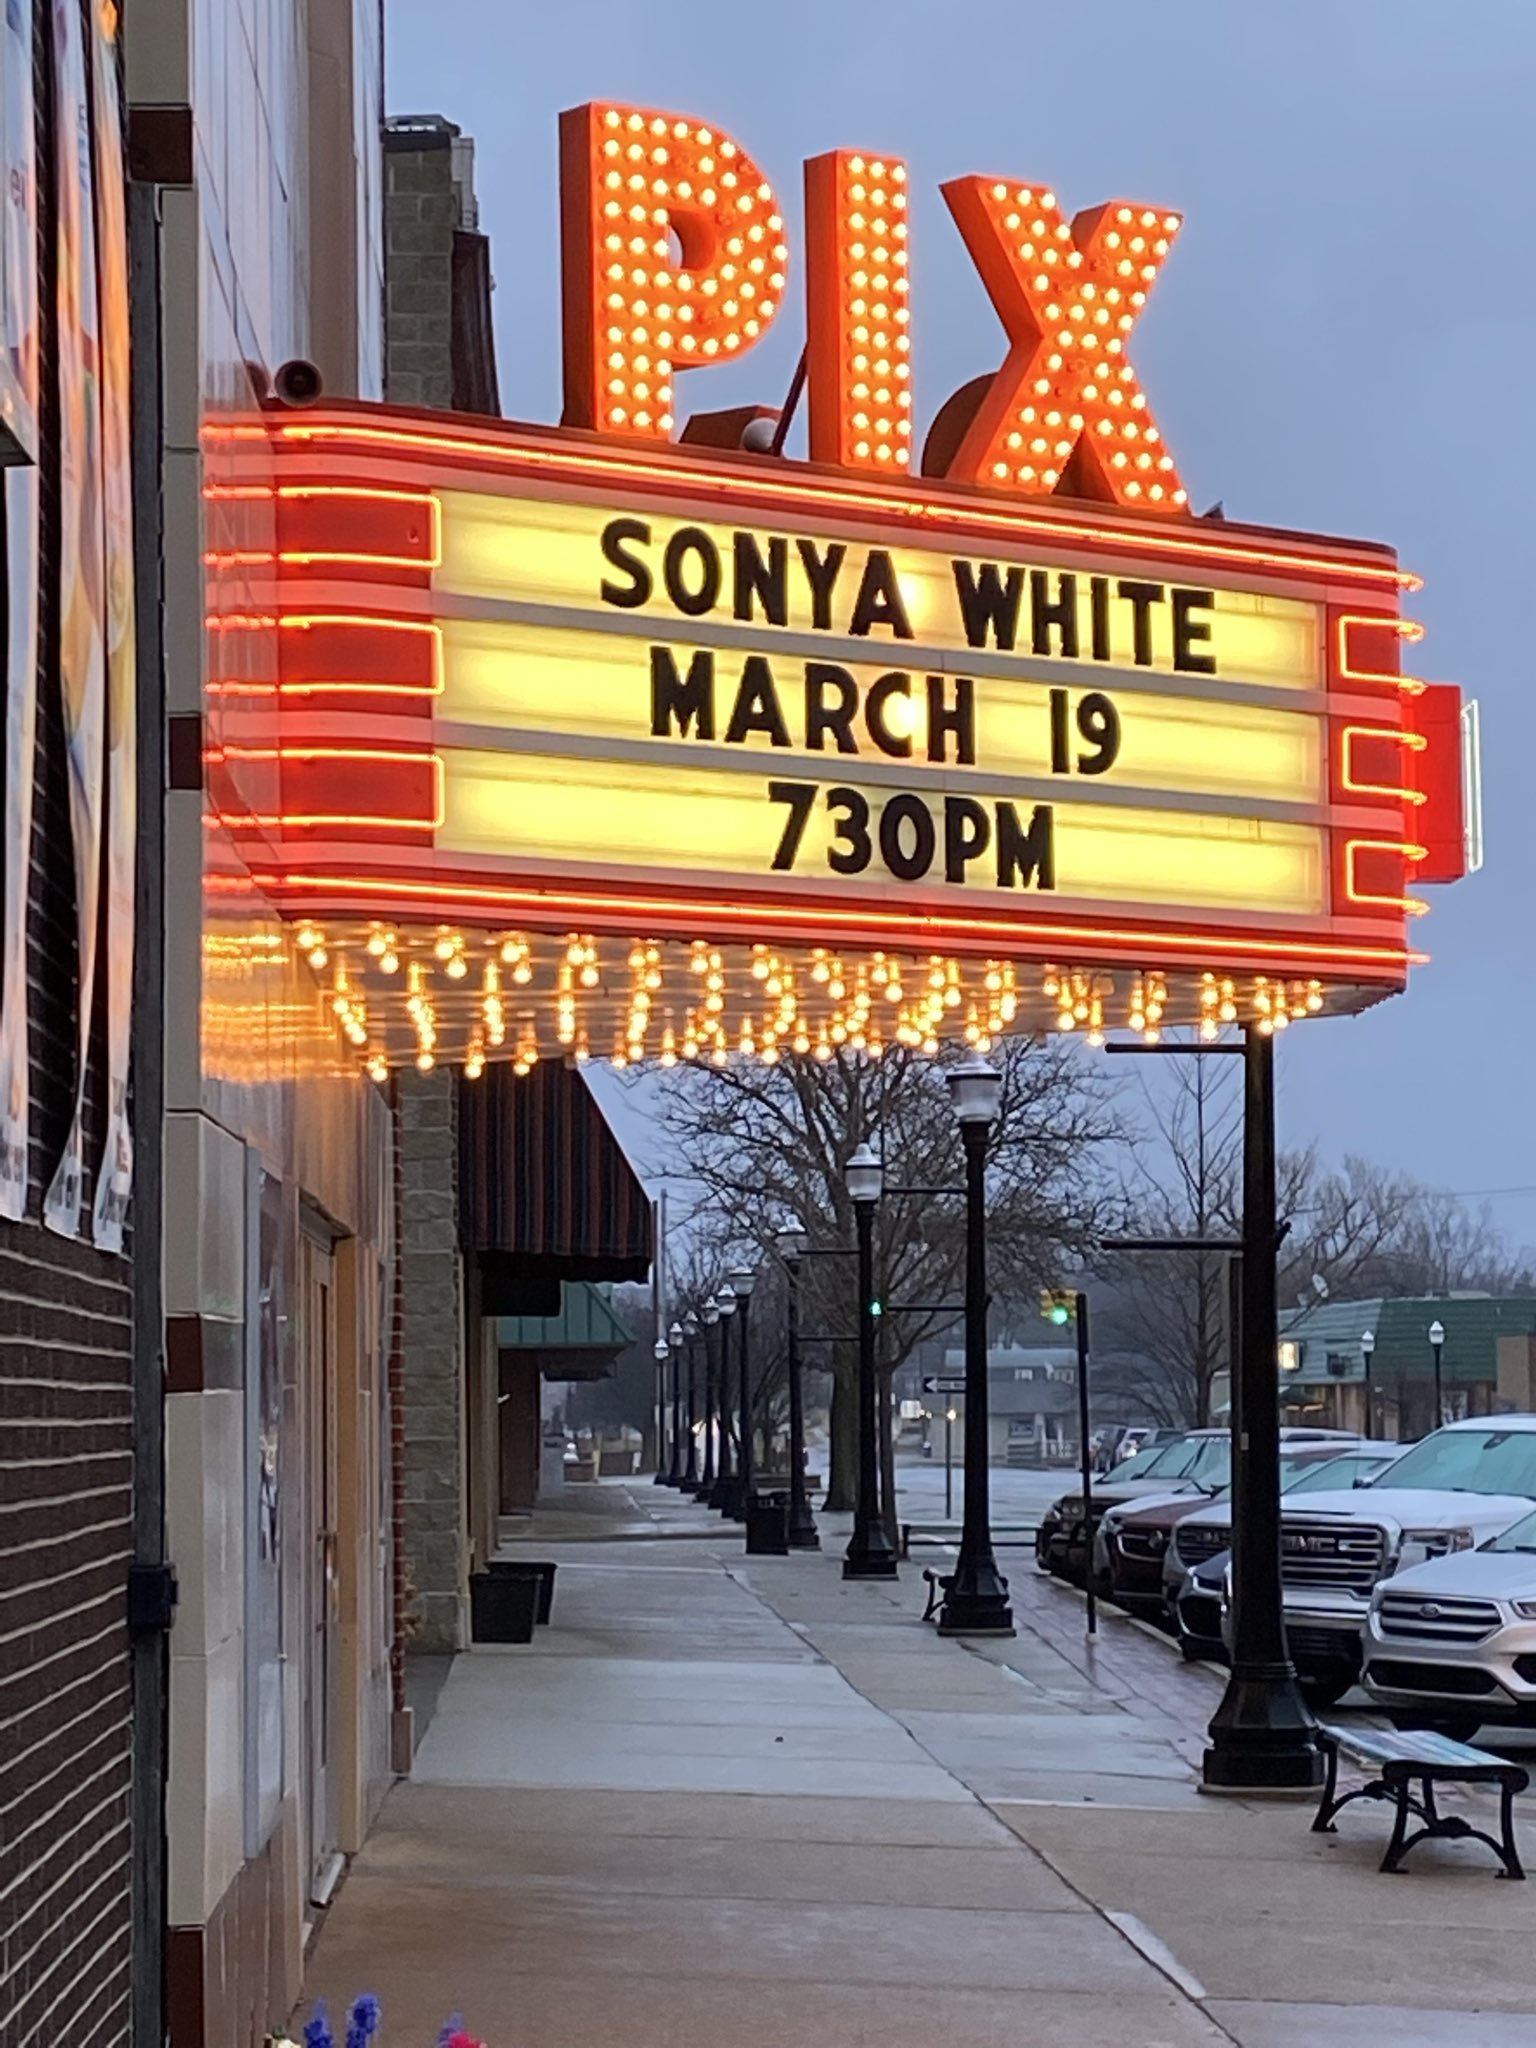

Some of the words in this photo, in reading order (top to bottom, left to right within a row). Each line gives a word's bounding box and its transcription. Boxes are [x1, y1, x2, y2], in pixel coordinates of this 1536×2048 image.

[559, 102, 1190, 515] PIX
[601, 518, 914, 640] SONYA
[952, 560, 1216, 675] WHITE
[649, 646, 975, 766] MARCH
[1050, 689, 1122, 775] 19
[769, 781, 1055, 891] 730PM
